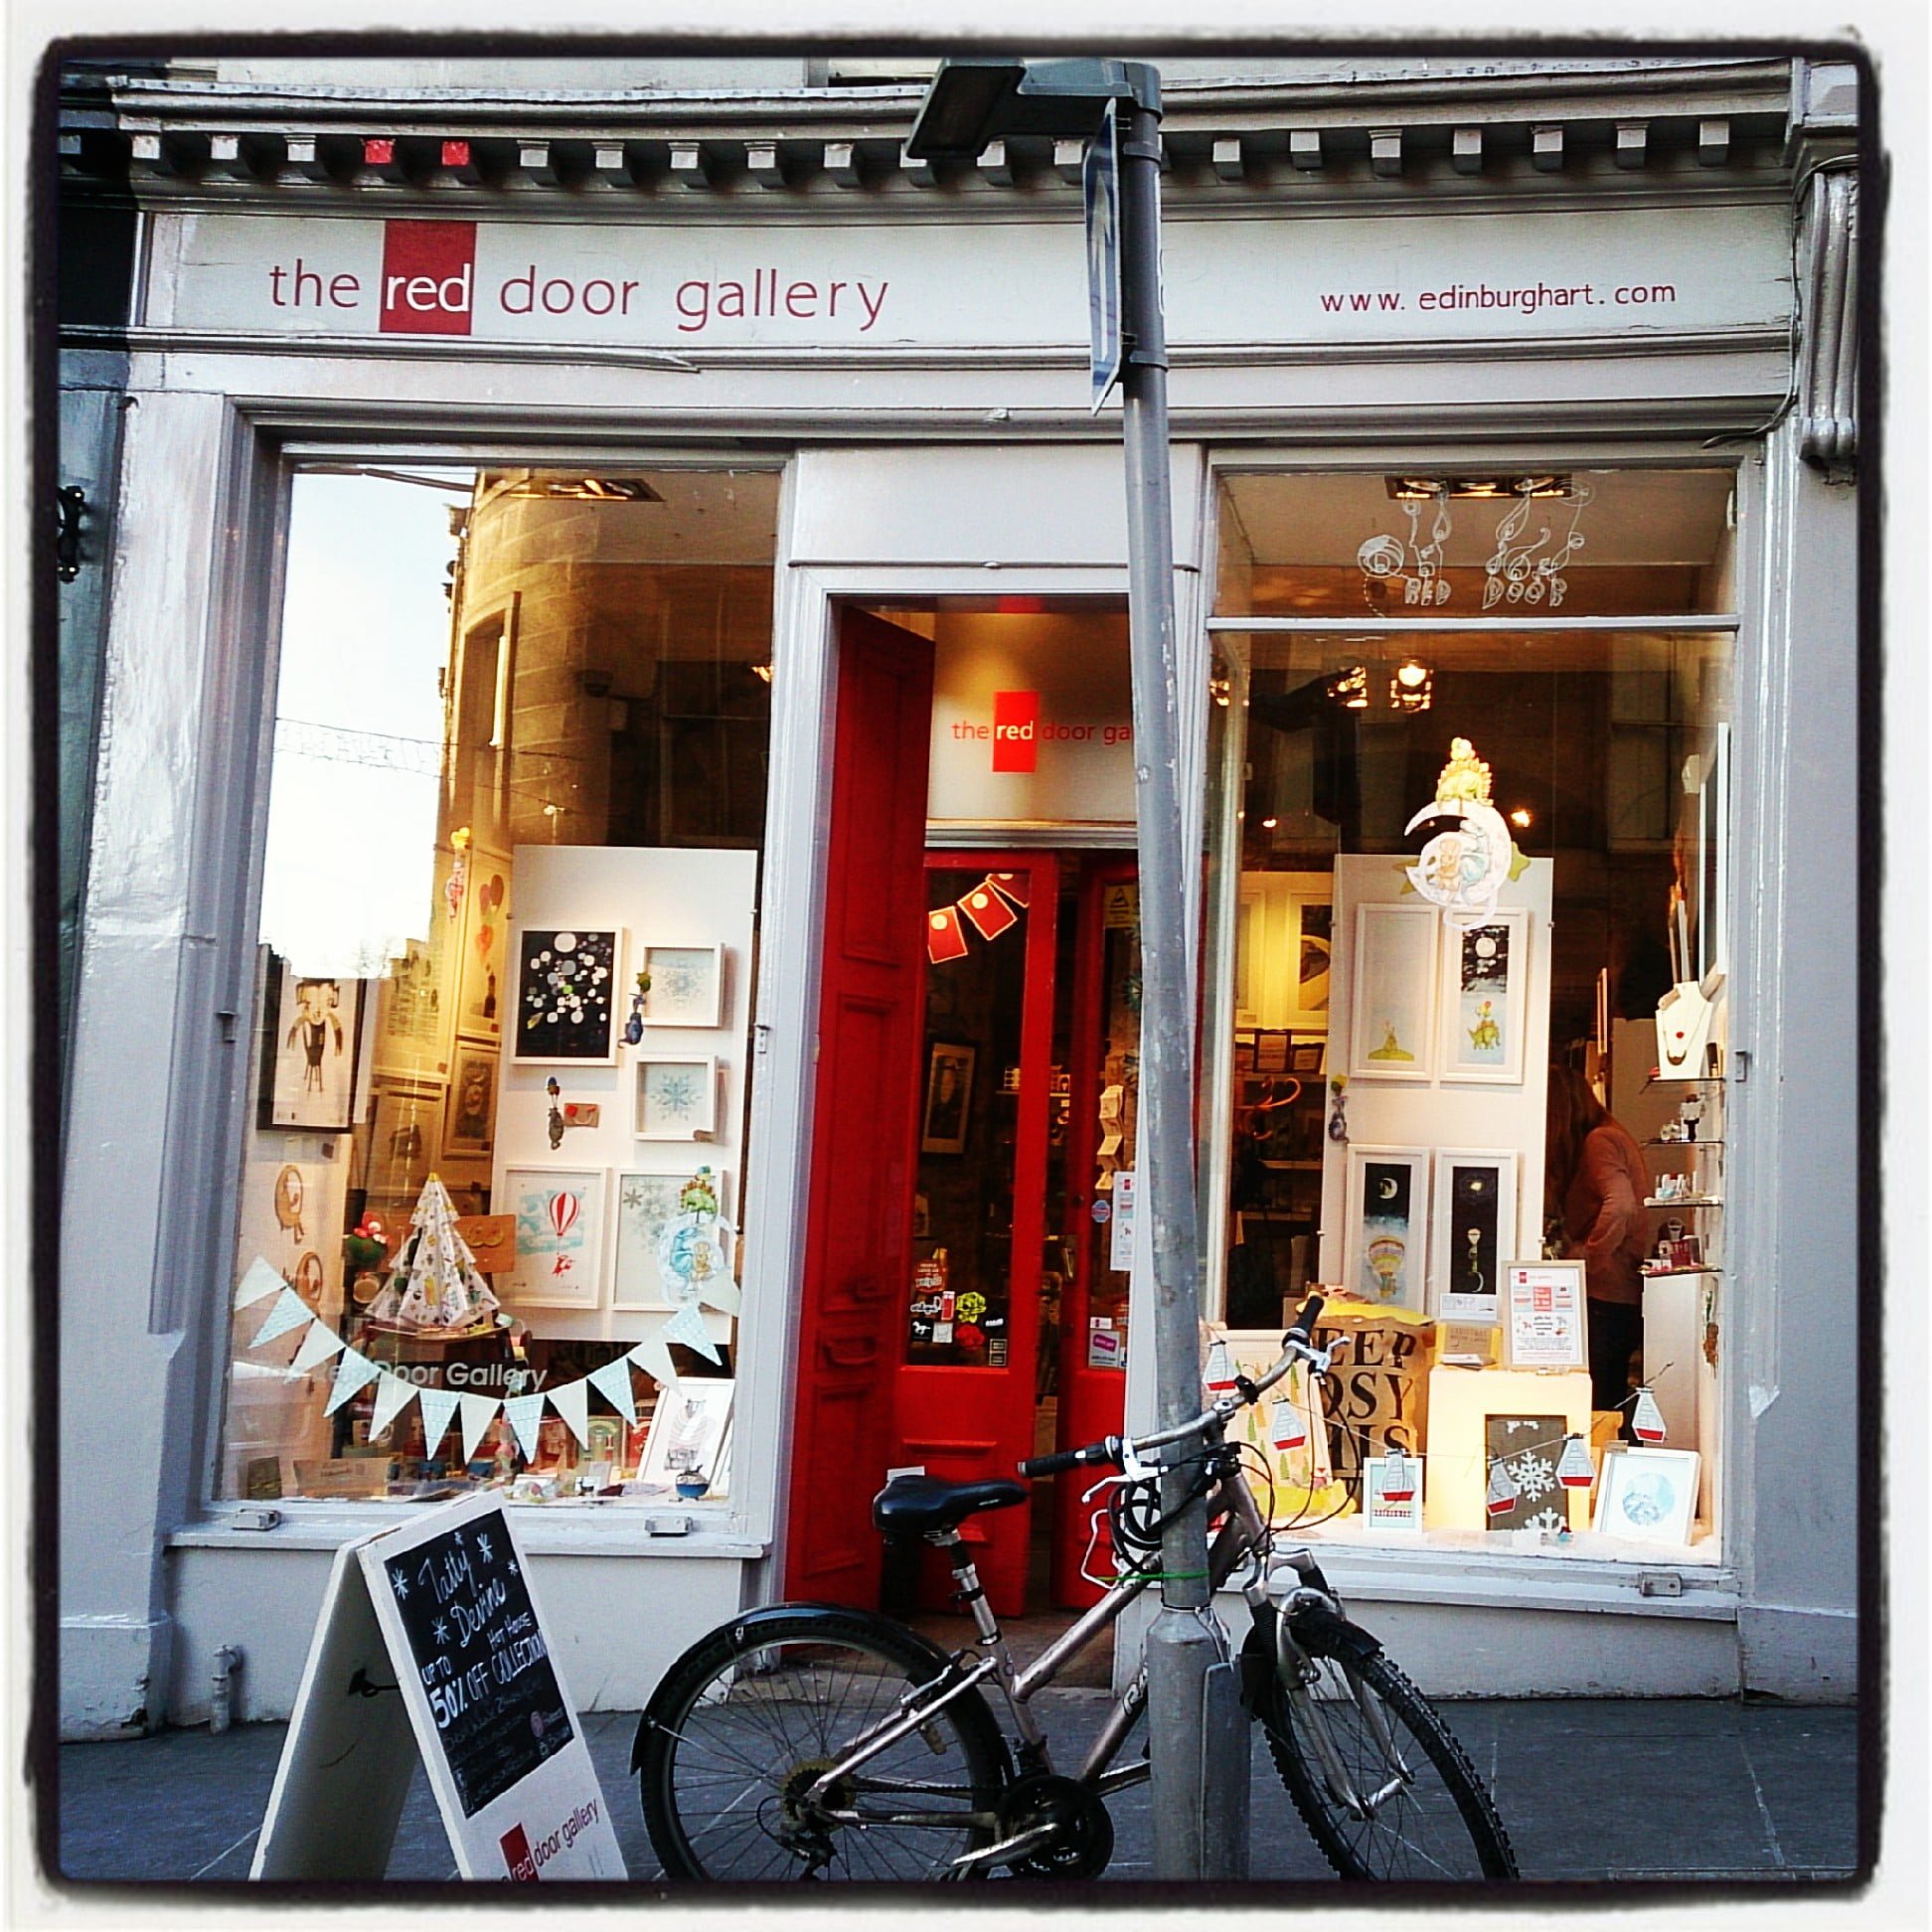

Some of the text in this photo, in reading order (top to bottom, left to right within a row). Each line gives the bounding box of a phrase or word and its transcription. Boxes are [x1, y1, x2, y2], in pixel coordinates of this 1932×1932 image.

[269, 257, 889, 332] the red door gallery
[951, 720, 1132, 746] the red door ga
[1315, 1327, 1417, 1370] EEP
[446, 1362, 548, 1392] Gallery
[1323, 1371, 1413, 1420] OSY
[421, 1655, 452, 1686] UP TO
[429, 1677, 468, 1729] 50%
[466, 1662, 489, 1700] OFF
[512, 1798, 600, 1881] red door gallery
